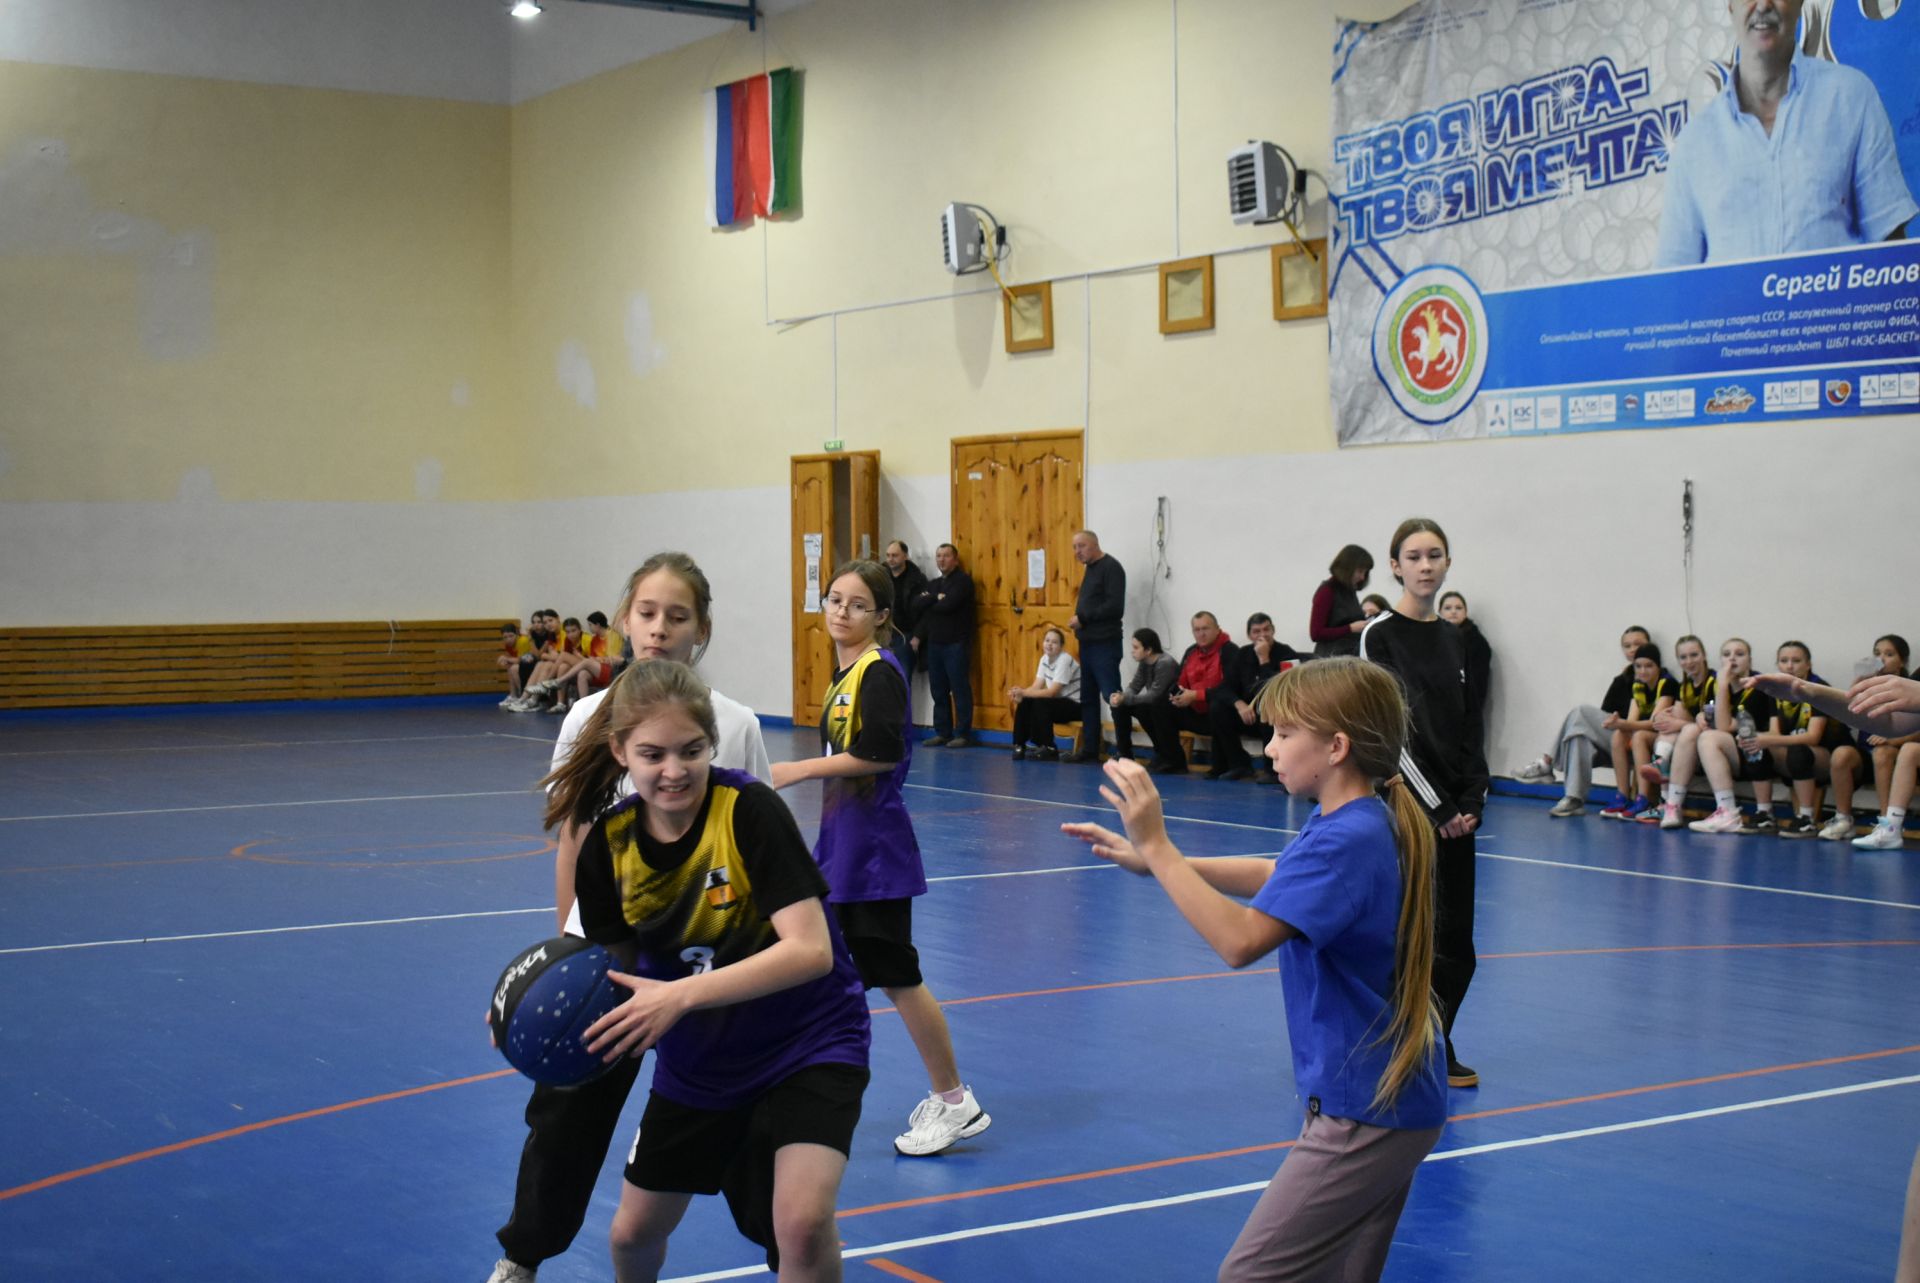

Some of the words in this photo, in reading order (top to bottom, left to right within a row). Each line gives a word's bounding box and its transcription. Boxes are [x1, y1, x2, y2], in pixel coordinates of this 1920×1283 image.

[1336, 101, 1476, 191] ТВОЯ
[1477, 55, 1650, 149] ИГРА-
[1338, 160, 1480, 247] ТВОЯ
[1762, 264, 1842, 300] Сергей
[1847, 263, 1920, 289] Белов
[1632, 319, 1690, 336] заслуженный
[1691, 318, 1725, 331] мастер
[1726, 314, 1760, 327] спорта
[1762, 310, 1786, 322] СССР,
[1788, 303, 1851, 321] заслуженный
[1853, 301, 1891, 315] тренер
[1893, 297, 1920, 311] СССР,
[1657, 333, 1711, 349] европейский
[1712, 326, 1779, 344] баскетболист
[1780, 327, 1800, 338] всех
[1801, 325, 1837, 339] времен
[1838, 322, 1851, 332] по
[1852, 319, 1886, 332] версии
[1888, 314, 1920, 327] ФИБА,
[1721, 344, 1768, 358] Почетный
[1770, 340, 1822, 355] президент
[1826, 336, 1849, 350] ШБЛ
